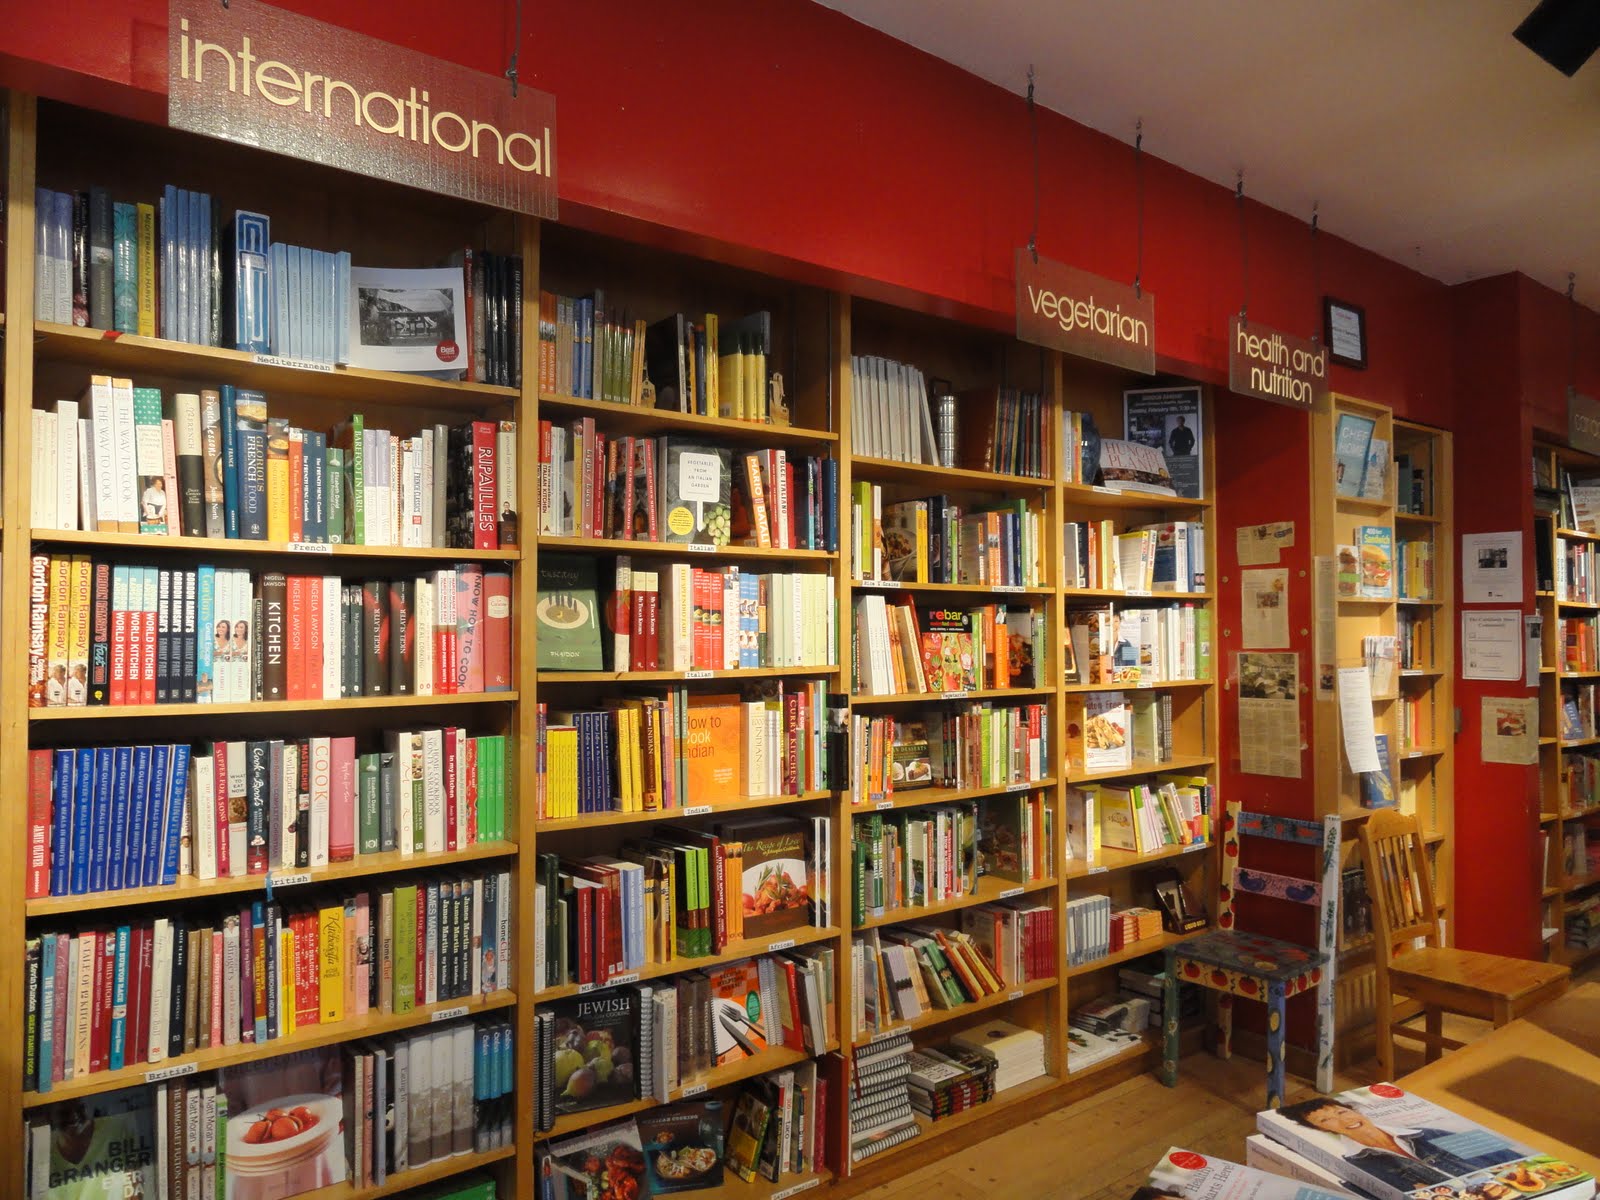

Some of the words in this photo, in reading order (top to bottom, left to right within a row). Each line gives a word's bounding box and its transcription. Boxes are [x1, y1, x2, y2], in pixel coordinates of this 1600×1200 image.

[180, 17, 552, 178] international
[1027, 285, 1148, 347] vegetarian
[1237, 322, 1289, 367] health
[1292, 348, 1324, 378] and
[257, 355, 332, 372] Mediterranean
[1251, 365, 1312, 404] nutrition
[98, 405, 108, 422] THE
[120, 408, 129, 425] THE
[99, 427, 109, 450] WAY
[121, 429, 130, 453] WAY
[101, 455, 109, 467] TO
[121, 457, 130, 469] TO
[248, 436, 256, 481] FRENCH
[1105, 442, 1159, 462] HUNGRY
[101, 472, 111, 502] COOK
[122, 474, 132, 503] COOK
[356, 478, 363, 487] IN
[479, 447, 493, 531] RIPAILLES
[249, 485, 257, 513] FOOD
[751, 458, 762, 495] MARIO
[757, 506, 768, 543] BATALI
[293, 544, 328, 552] French
[1364, 534, 1390, 544] Sandwich
[32, 557, 48, 601] Gordon
[59, 561, 69, 601] Gordon
[79, 560, 90, 601] Gordon
[160, 571, 169, 599] GORDON
[540, 568, 579, 586] tuscany
[472, 575, 482, 606] KNOW
[115, 612, 124, 642] WORLD
[130, 612, 139, 642] WORLD
[159, 600, 168, 633] RAMSAY'S
[467, 610, 477, 635] HOW
[929, 608, 963, 621] rebar
[30, 604, 48, 656] Ramsay
[55, 605, 68, 657] Ramsay's
[76, 604, 89, 657] Ramsay's
[145, 612, 155, 643] WORLD
[269, 602, 281, 664] KITCHEN
[159, 638, 167, 661] FAMILY
[463, 639, 473, 654] TO
[114, 644, 124, 680] KITCHEN
[130, 644, 139, 680] KITCHEN
[144, 645, 154, 680] KITCHEN
[158, 662, 167, 677] FARE
[457, 657, 470, 688] COOK
[710, 716, 722, 728] to
[175, 749, 186, 785] JAMIE'S
[216, 750, 226, 777] SUPPER
[254, 748, 265, 771] Cook
[448, 763, 455, 772] my
[314, 746, 329, 802] COOK
[253, 778, 265, 807] Boots
[219, 802, 227, 822] SONG
[33, 825, 43, 844] JAMIE
[32, 845, 44, 867] OLIVER
[168, 836, 177, 867] MEALS
[860, 880, 865, 888] TO
[429, 887, 437, 915] JAMES
[499, 919, 508, 963] homeChef
[770, 941, 793, 951] African
[82, 948, 90, 972] TALE
[118, 953, 126, 983] BURTON
[442, 956, 446, 964] my
[45, 976, 53, 990] THE
[81, 974, 89, 987] OF
[610, 976, 638, 986] Eastern
[44, 991, 53, 1019] PARTING
[81, 989, 88, 999] 12
[117, 984, 125, 1003] RACE
[438, 1009, 463, 1019] Irish
[578, 998, 630, 1018] JEWISH
[43, 1020, 52, 1042] GLASS
[80, 1001, 88, 1050] KITCHENS
[148, 1065, 194, 1081] British
[684, 1086, 706, 1096] Jewish
[189, 1096, 198, 1115] Matt
[206, 1096, 214, 1114] Matt
[190, 1117, 198, 1143] Moran
[206, 1116, 214, 1142] Moran
[784, 1120, 792, 1140] taco
[109, 1140, 149, 1158] BILL
[50, 1151, 150, 1189] GRANGER
[1185, 1166, 1215, 1192] Healthy
[1213, 1163, 1235, 1182] Here!
